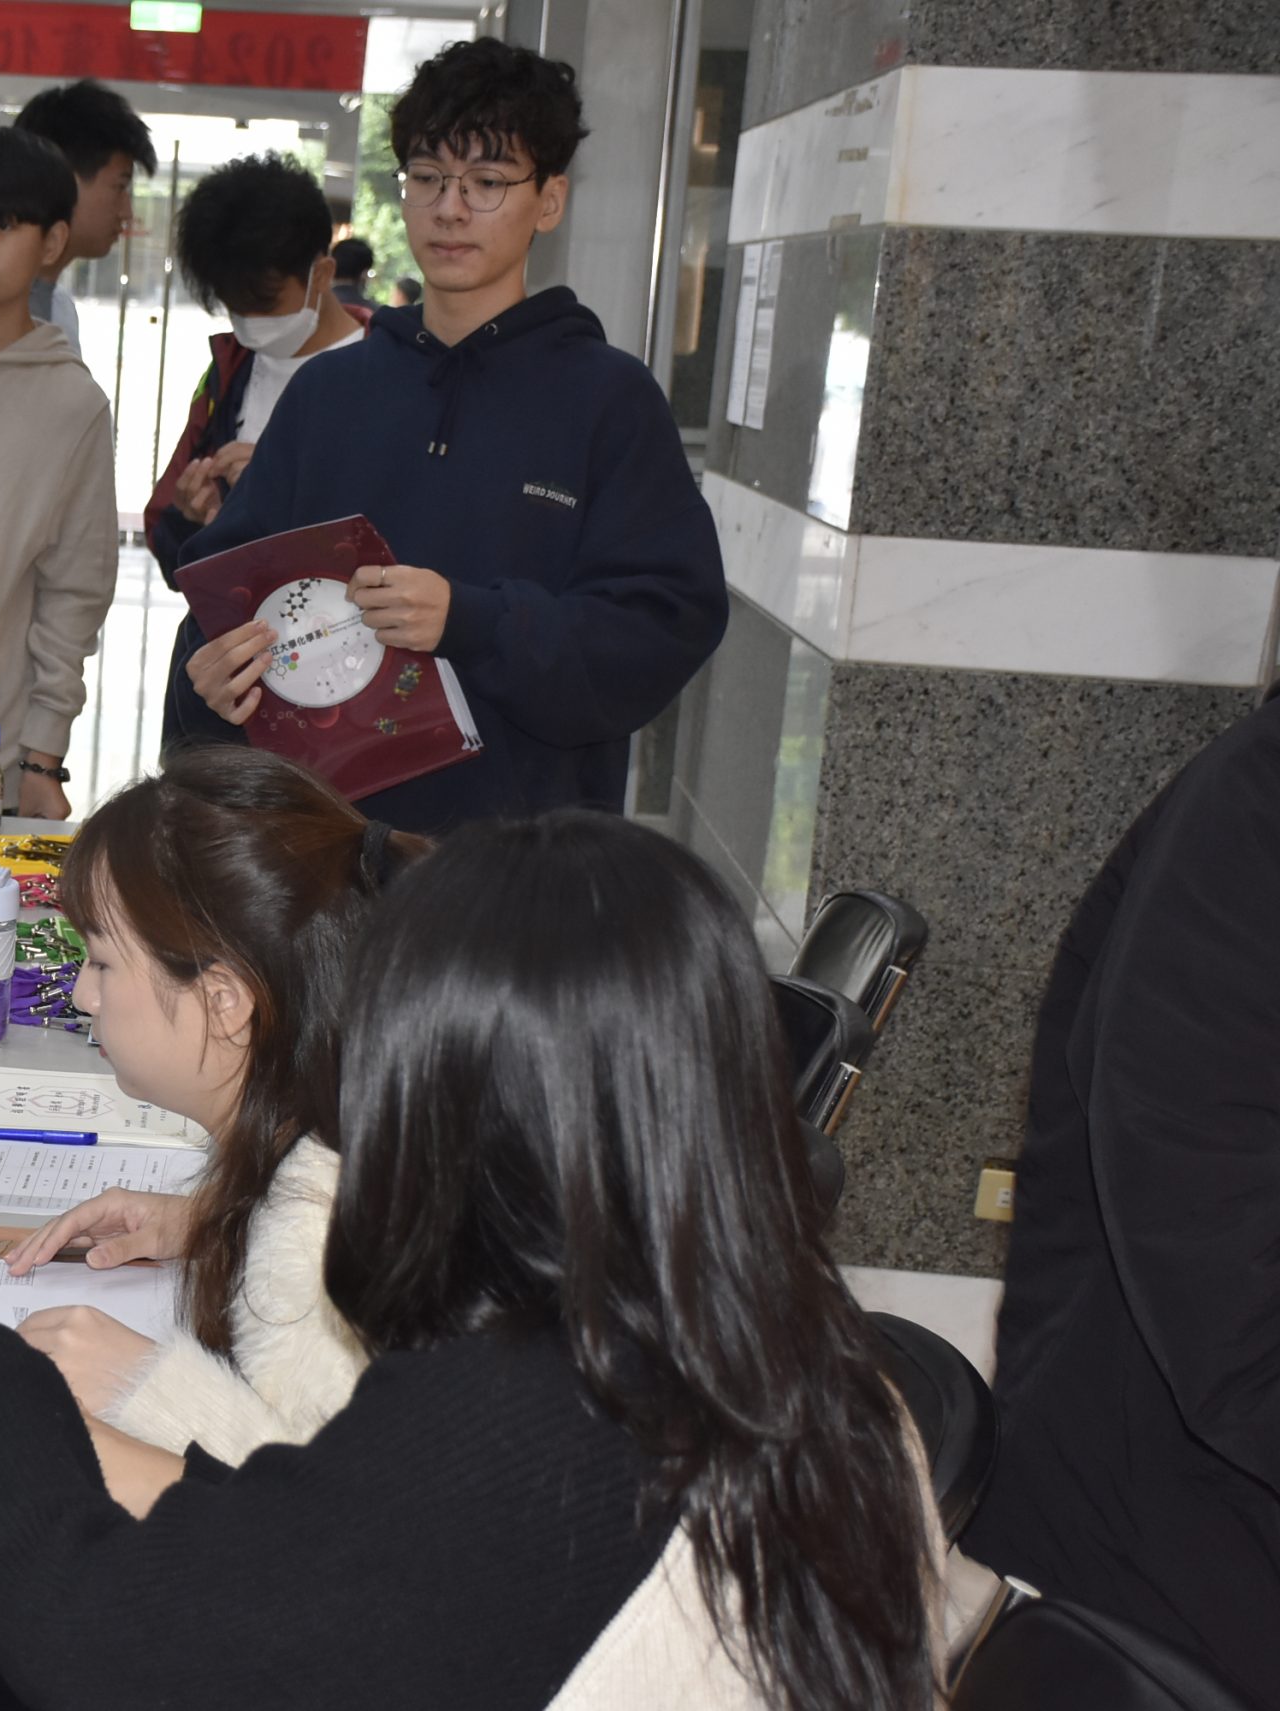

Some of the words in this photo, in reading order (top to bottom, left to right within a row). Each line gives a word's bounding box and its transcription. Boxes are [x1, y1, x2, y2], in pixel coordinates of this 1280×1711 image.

[522, 483, 546, 497] WEIRD
[546, 489, 578, 509] JOURNEY
[267, 629, 324, 656] 江大學化學系
